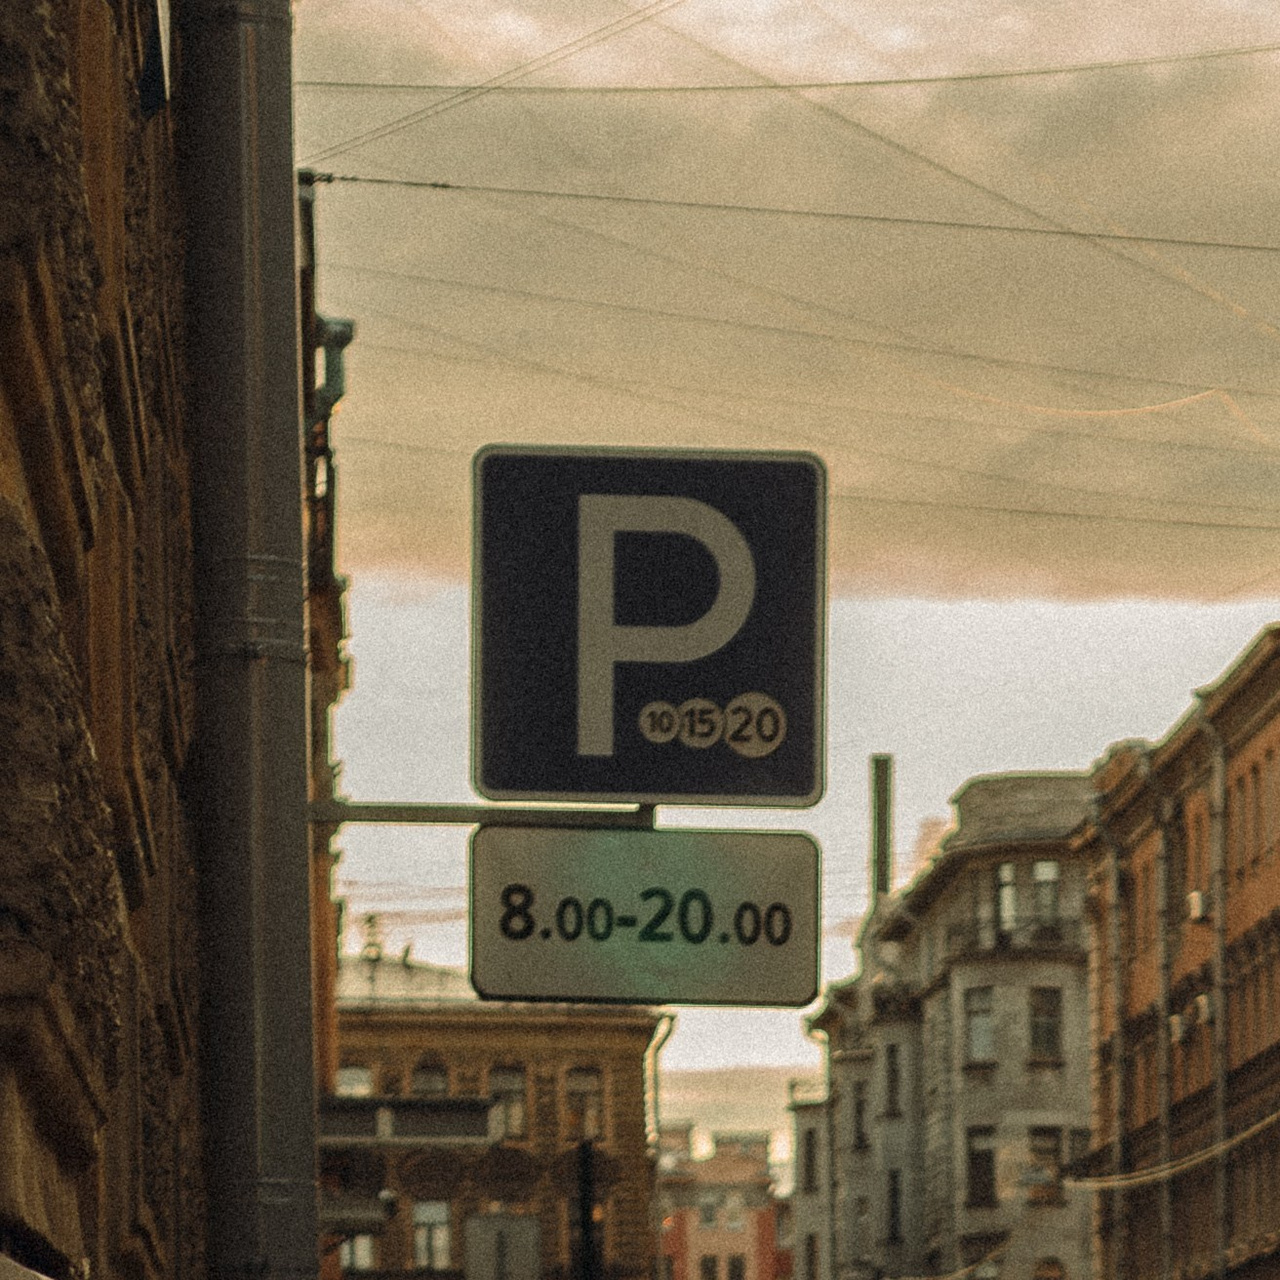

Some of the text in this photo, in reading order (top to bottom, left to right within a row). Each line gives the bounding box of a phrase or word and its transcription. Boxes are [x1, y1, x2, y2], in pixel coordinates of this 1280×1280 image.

[577, 493, 757, 757] P
[646, 705, 781, 743] 10 15 20
[499, 882, 793, 948] 8.00-20.00
